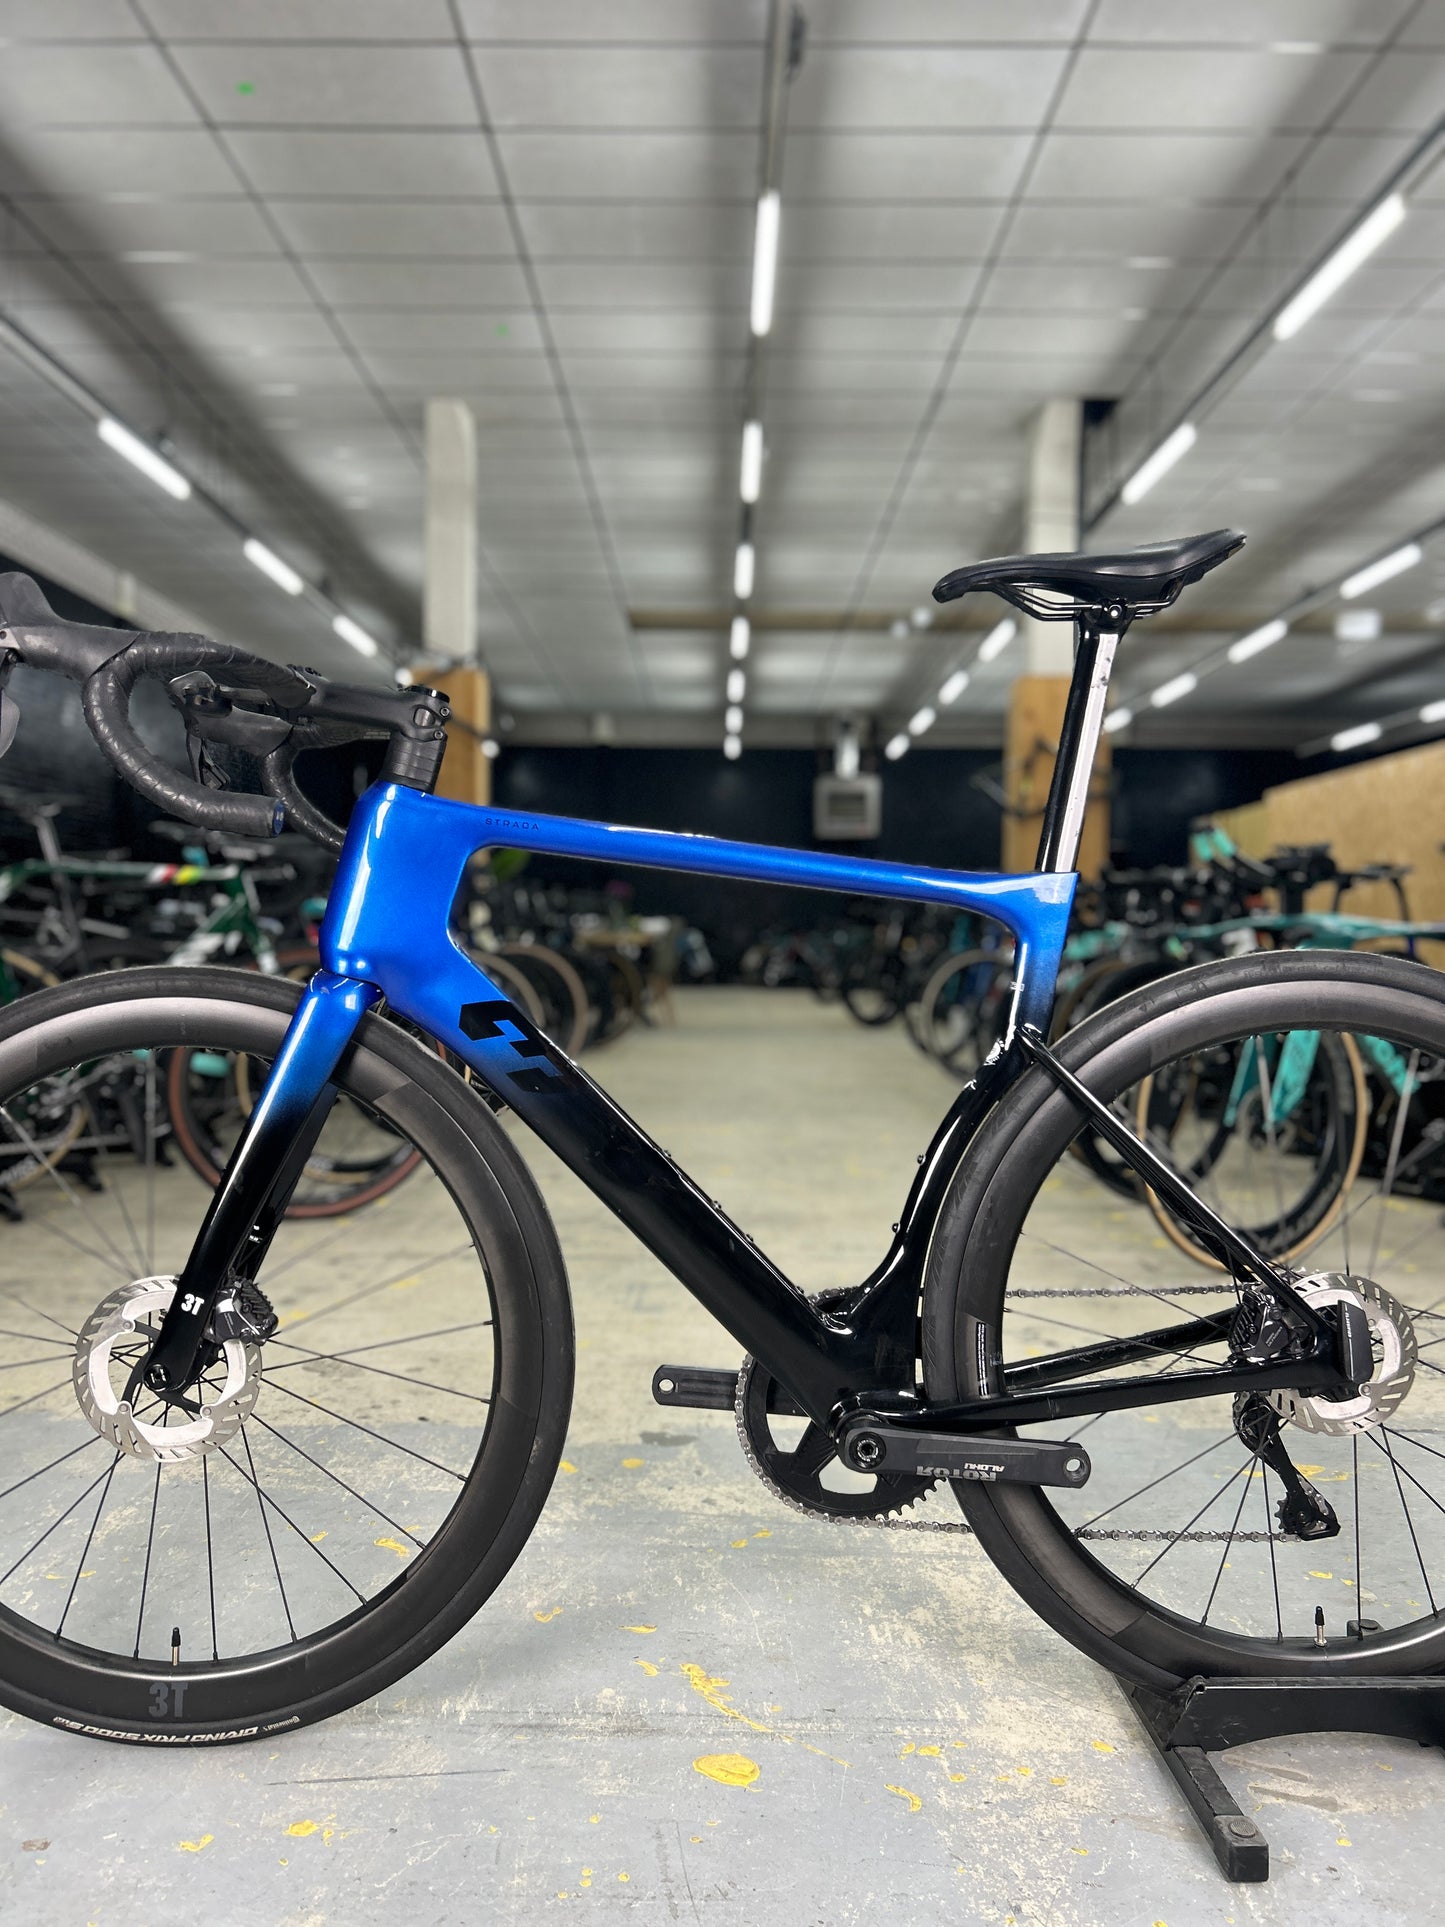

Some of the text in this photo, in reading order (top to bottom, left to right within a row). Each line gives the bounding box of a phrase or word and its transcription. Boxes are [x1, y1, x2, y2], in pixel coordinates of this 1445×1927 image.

[485, 817, 539, 831] STRADA
[181, 1293, 205, 1316] 3T
[916, 1466, 998, 1482] ROTOR
[149, 1681, 189, 1718] 3T
[82, 1725, 142, 1740] 5000
[142, 1733, 192, 1743] PRIX
[190, 1726, 259, 1742] GRAND
